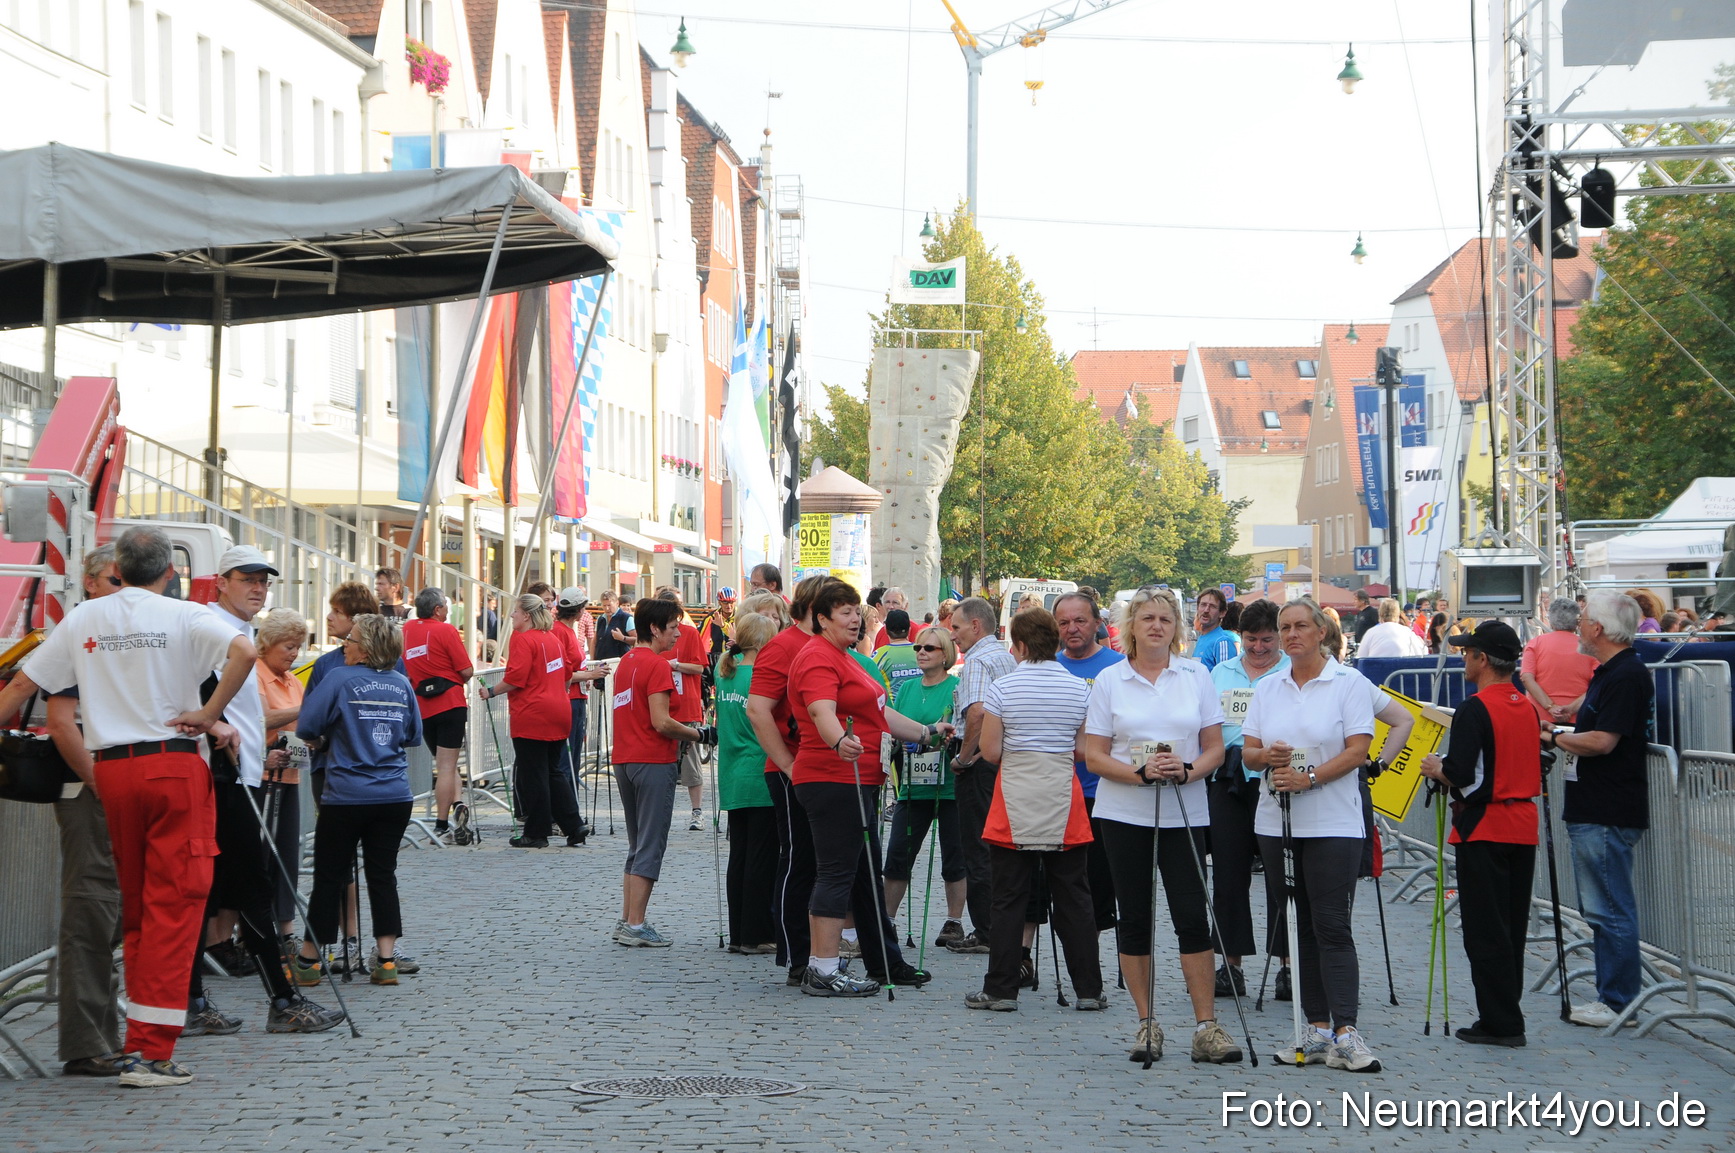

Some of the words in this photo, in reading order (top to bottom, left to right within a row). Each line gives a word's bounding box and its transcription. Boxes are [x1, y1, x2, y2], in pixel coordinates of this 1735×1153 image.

[914, 270, 953, 285] DAV
[1404, 468, 1443, 482] swn
[98, 639, 167, 652] WOFFENBACH
[914, 762, 940, 773] 8042
